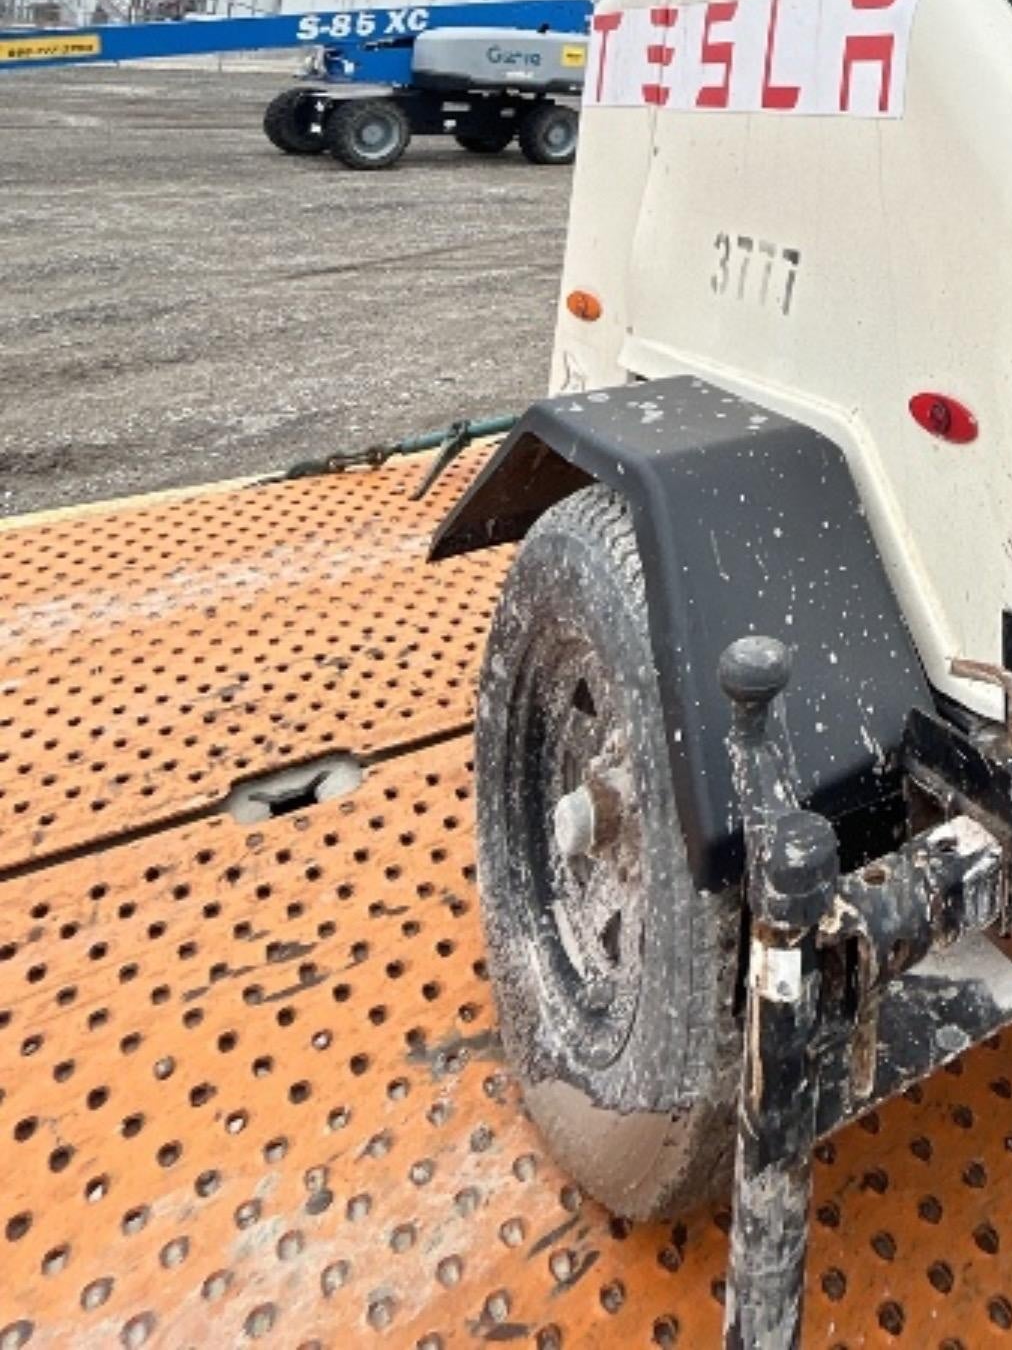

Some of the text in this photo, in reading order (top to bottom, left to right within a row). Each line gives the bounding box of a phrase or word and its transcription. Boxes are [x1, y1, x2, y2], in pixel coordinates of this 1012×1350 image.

[296, 9, 429, 40] S-85 XC
[711, 232, 800, 316] 3777
